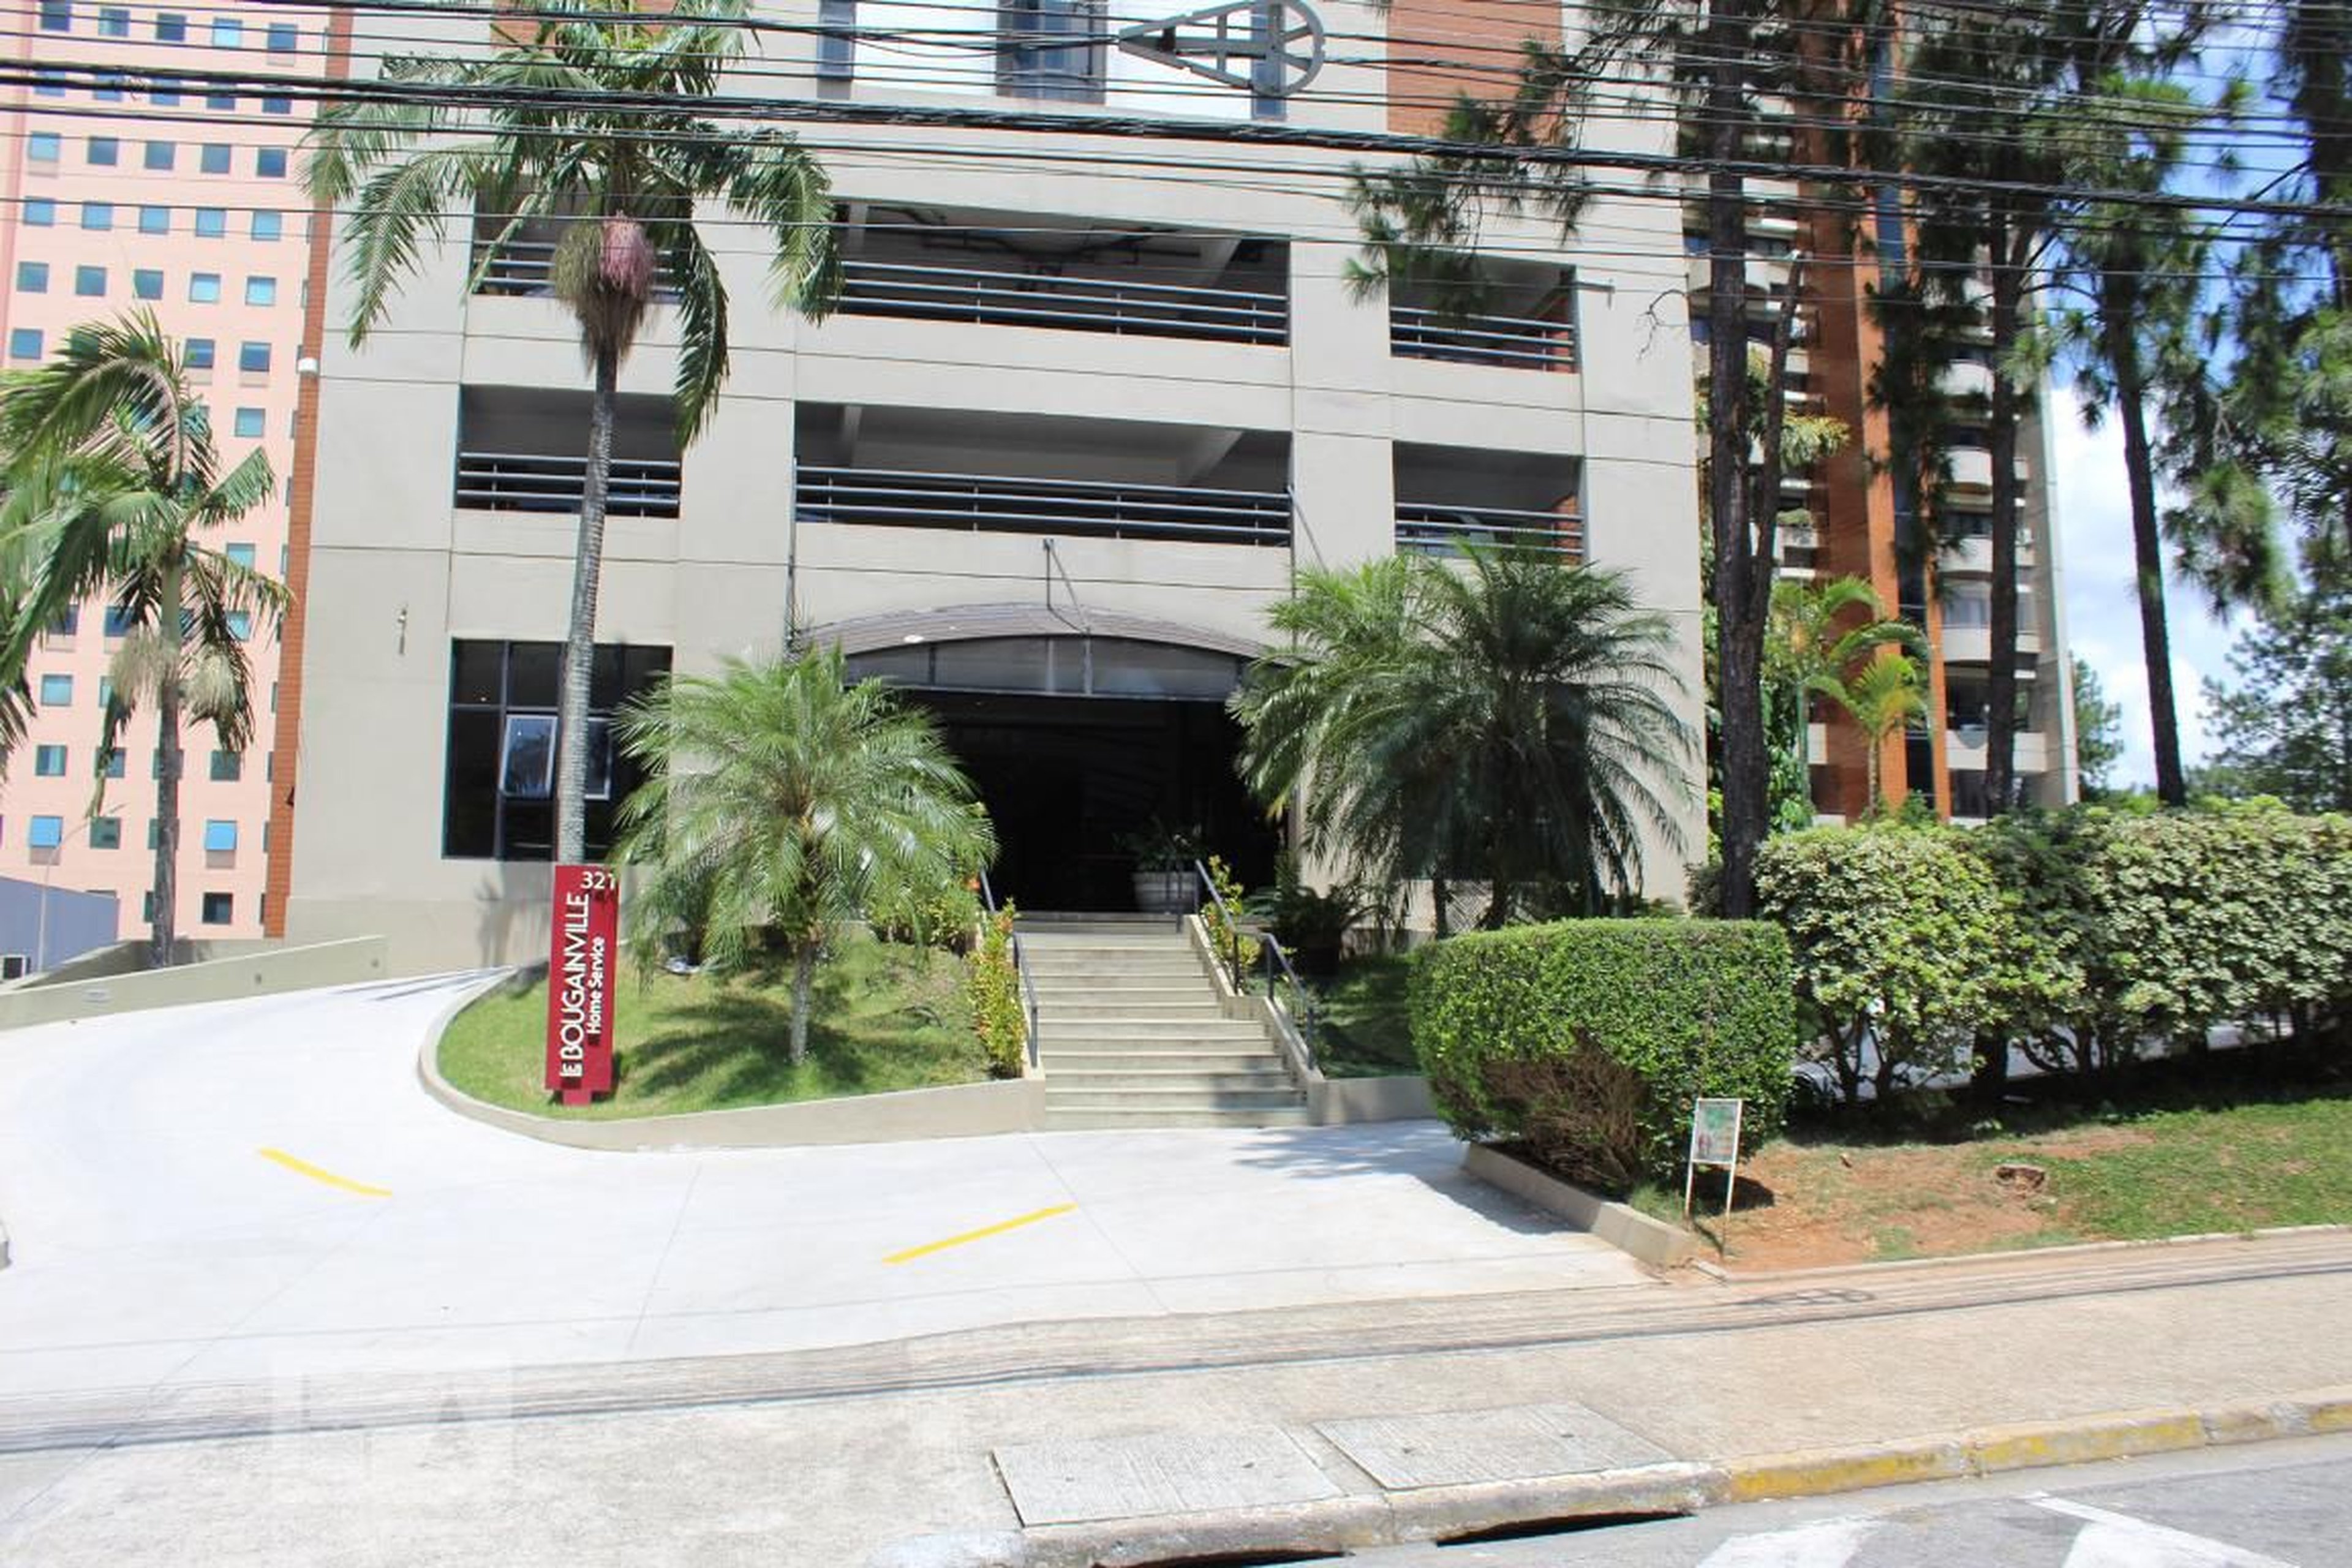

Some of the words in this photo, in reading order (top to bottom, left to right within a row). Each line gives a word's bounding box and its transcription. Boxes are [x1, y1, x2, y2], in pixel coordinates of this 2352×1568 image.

[579, 871, 615, 891] 321
[560, 892, 589, 1060] BOUGAINVILLE
[586, 936, 605, 989] Service
[586, 990, 603, 1034] Home
